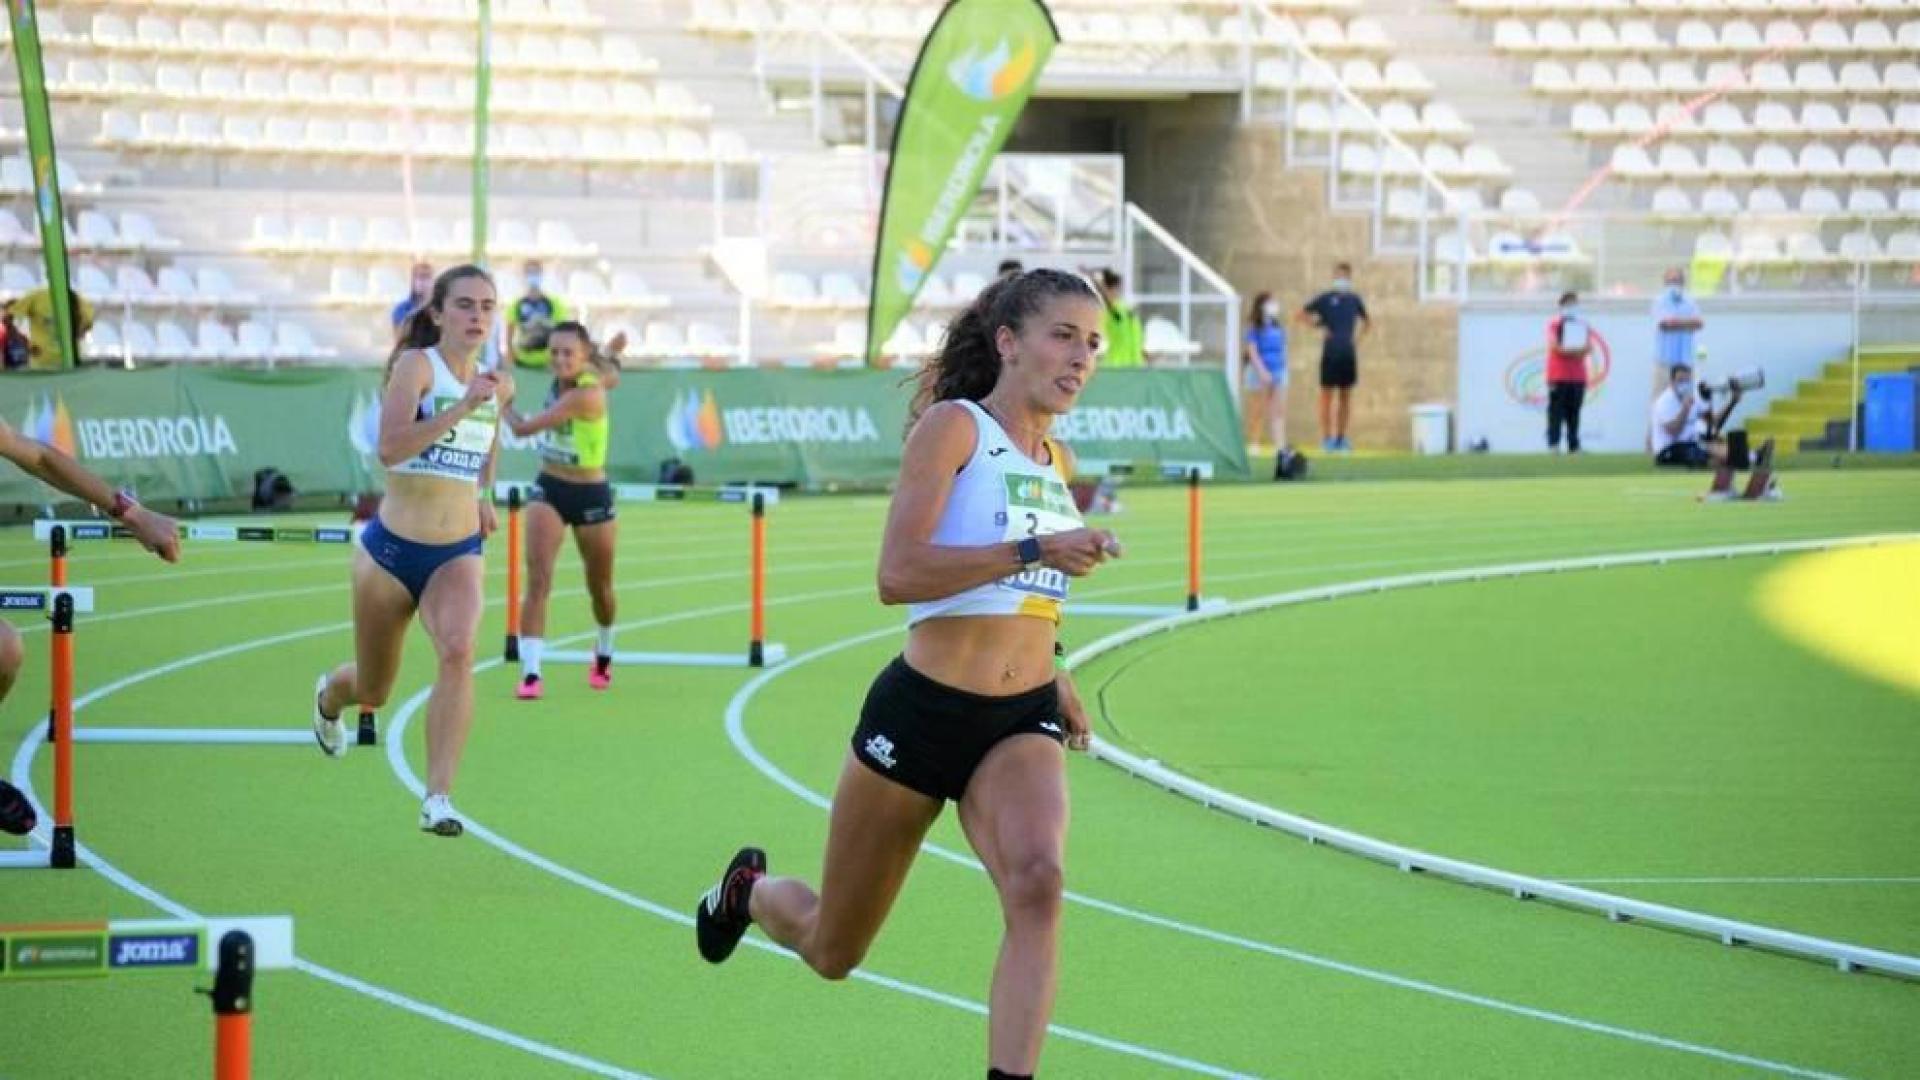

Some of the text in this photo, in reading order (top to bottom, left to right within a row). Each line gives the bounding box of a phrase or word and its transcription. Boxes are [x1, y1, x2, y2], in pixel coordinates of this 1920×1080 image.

[77, 414, 238, 458] IBERDROLA
[723, 406, 880, 444] IBERDROLA
[1053, 407, 1196, 441] BERDROLA
